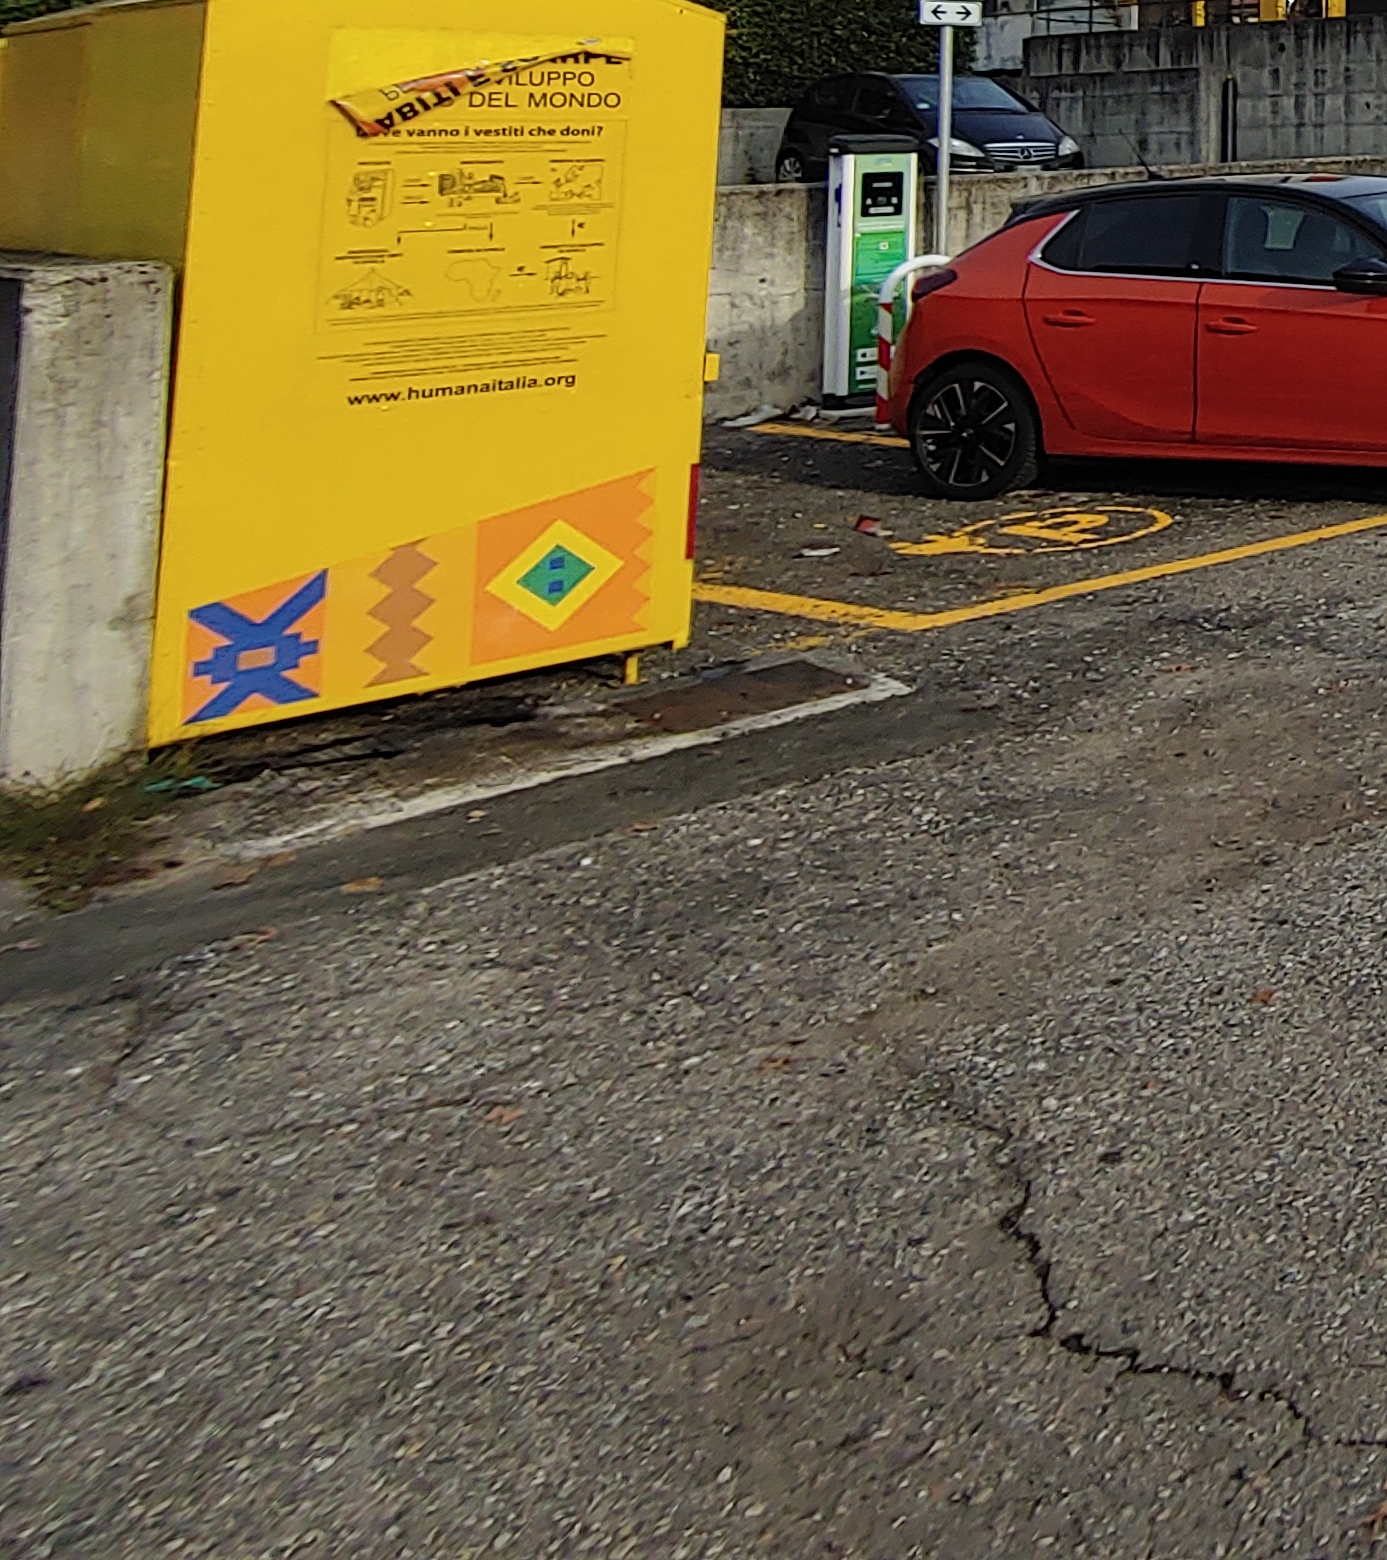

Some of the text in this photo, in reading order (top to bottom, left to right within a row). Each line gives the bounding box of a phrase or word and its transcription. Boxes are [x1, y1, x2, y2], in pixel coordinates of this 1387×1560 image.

[495, 70, 595, 87] ILUPPO
[468, 92, 621, 108] DEL MONDO
[406, 128, 460, 138] vanno
[474, 126, 524, 138] vestiti
[528, 126, 557, 137] che
[560, 126, 604, 137] doni?
[347, 374, 576, 405] www.humanaitalia.org
